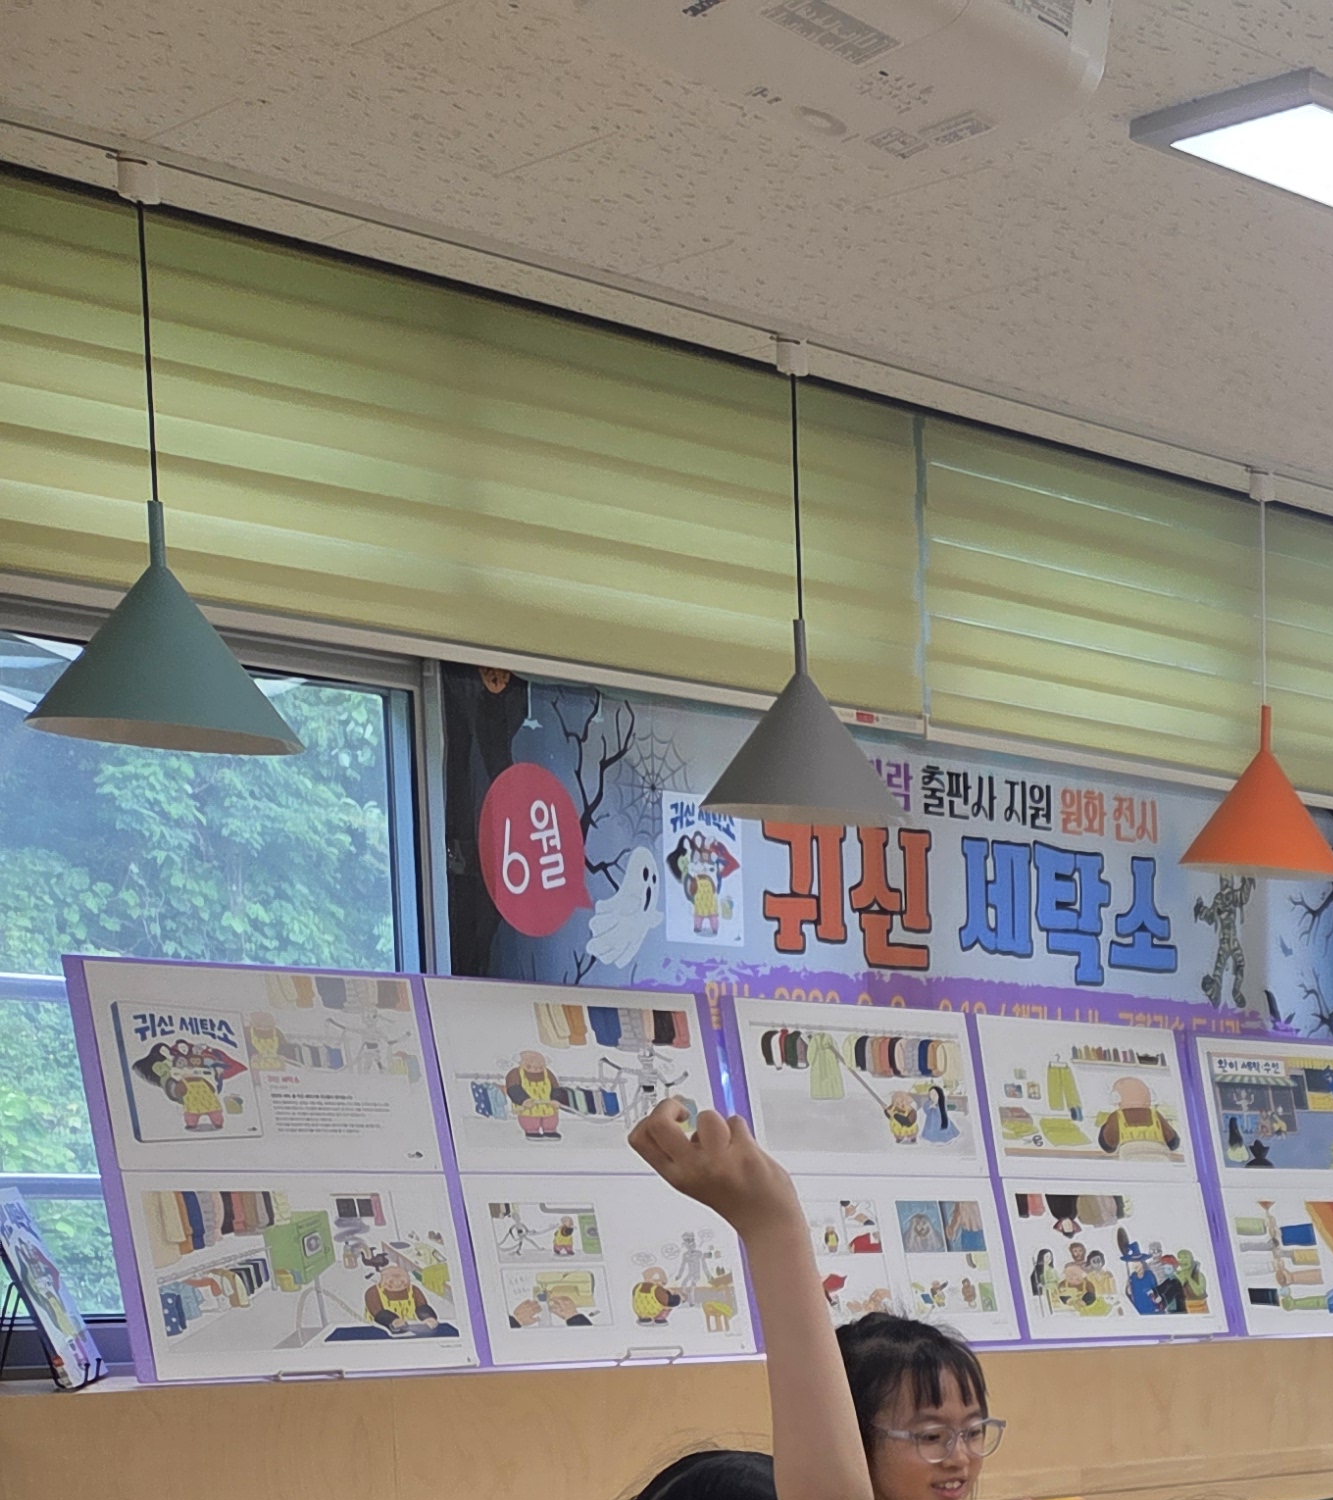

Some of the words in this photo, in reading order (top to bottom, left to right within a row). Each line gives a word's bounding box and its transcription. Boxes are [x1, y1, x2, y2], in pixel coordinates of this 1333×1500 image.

[502, 799, 567, 895] 6월
[921, 764, 998, 823] 출판사
[1004, 779, 1052, 832] 지원
[1060, 787, 1106, 837] 원화
[1112, 793, 1159, 845] 전시
[761, 819, 933, 972] 귀신
[958, 835, 1179, 987] 세탁소
[133, 1012, 175, 1042] 귀신
[179, 1016, 239, 1049] 세탁소
